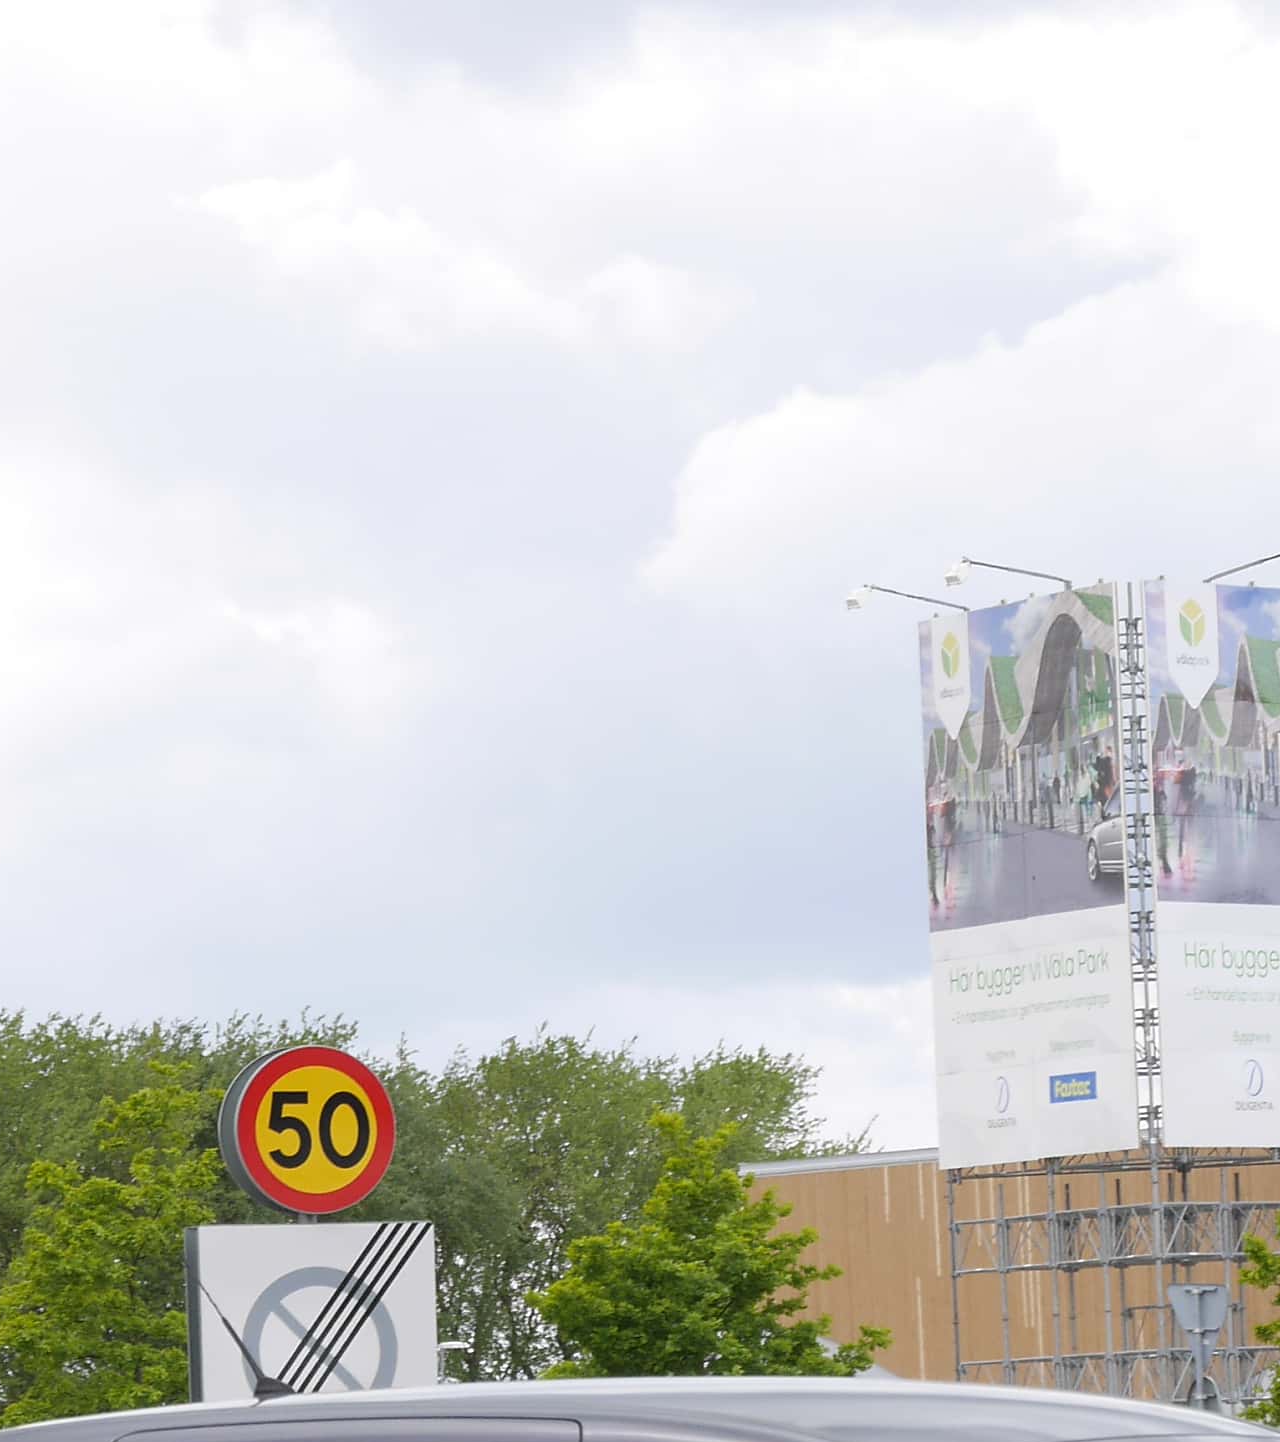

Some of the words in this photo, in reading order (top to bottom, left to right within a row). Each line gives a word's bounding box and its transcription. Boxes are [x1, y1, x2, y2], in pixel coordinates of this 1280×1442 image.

[977, 960, 1026, 998] bygger
[1030, 958, 1041, 982] vi
[1077, 946, 1110, 975] Park
[1183, 942, 1216, 969] Här
[268, 1091, 370, 1168] 50
